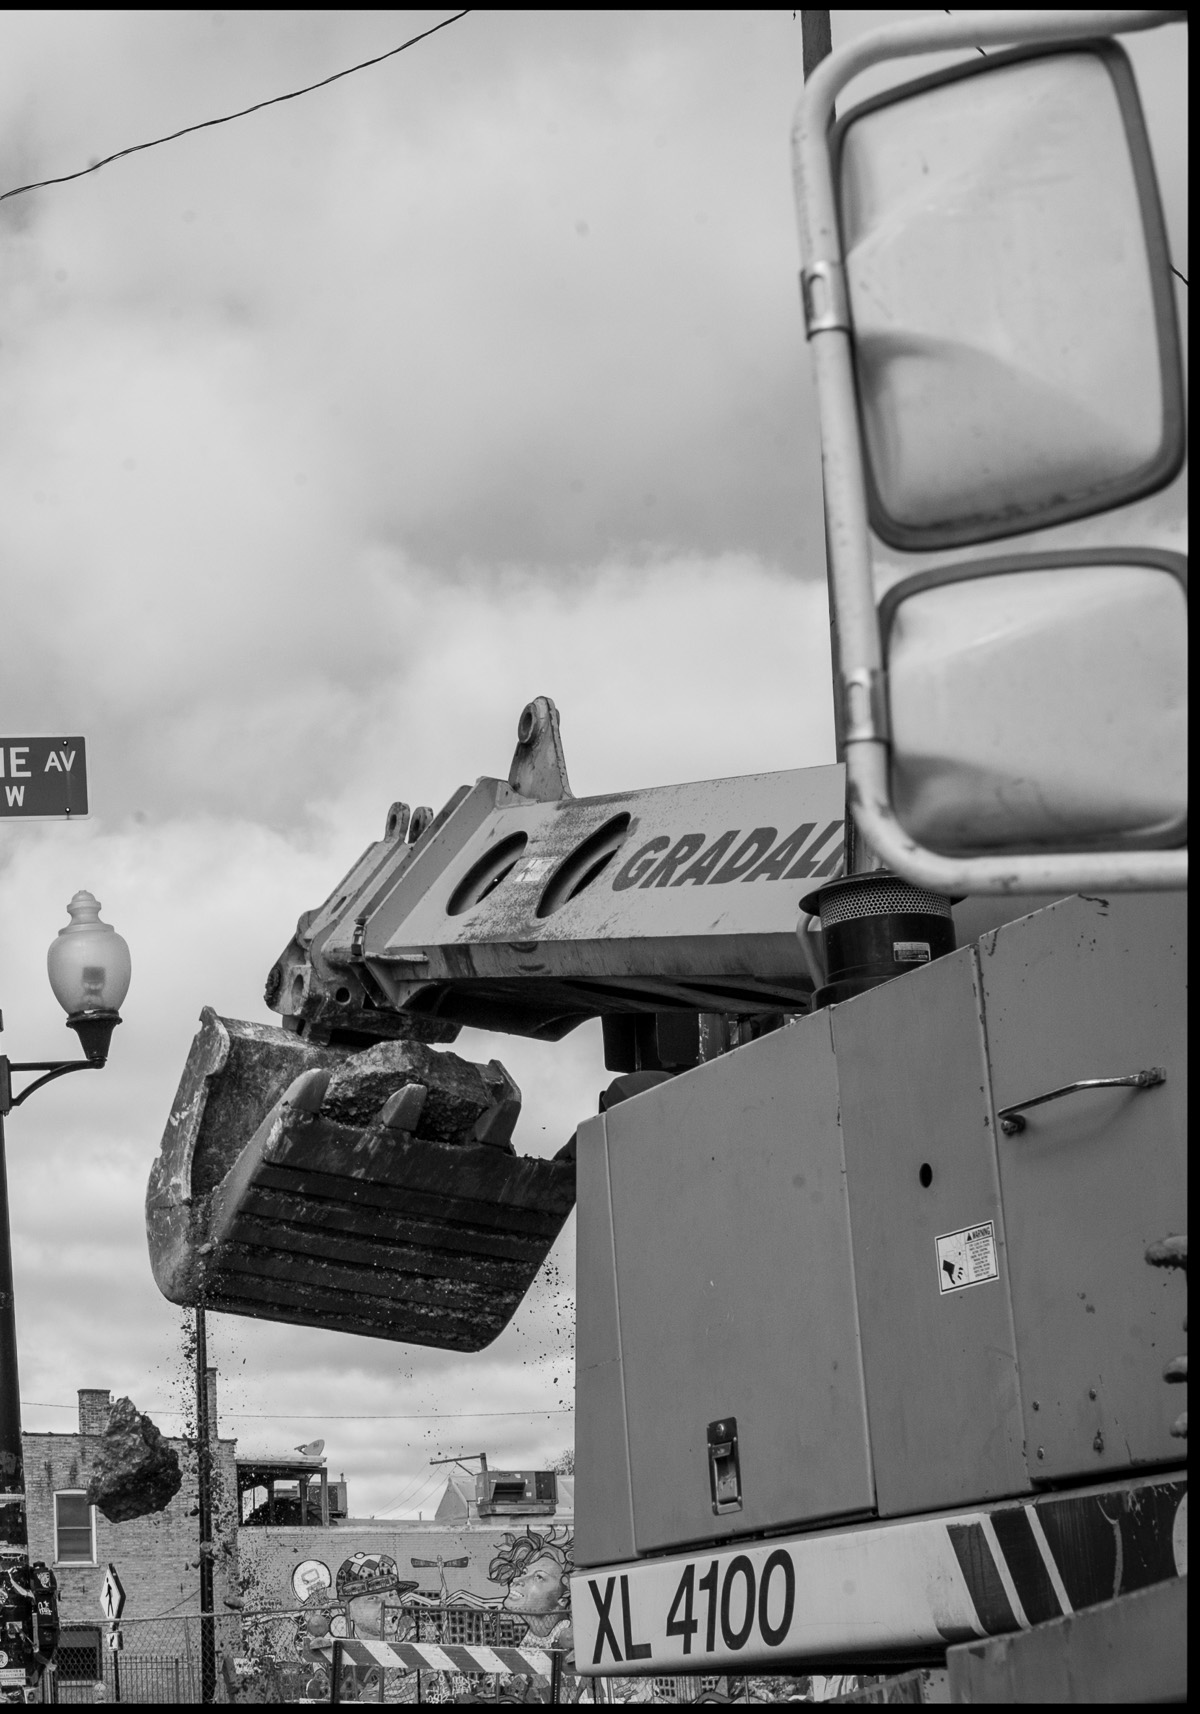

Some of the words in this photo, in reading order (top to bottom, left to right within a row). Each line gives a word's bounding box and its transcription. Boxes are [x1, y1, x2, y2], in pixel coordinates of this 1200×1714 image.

[43, 751, 76, 772] AV
[5, 785, 25, 807] W
[587, 1574, 653, 1665] XL
[665, 1548, 796, 1656] 4100
